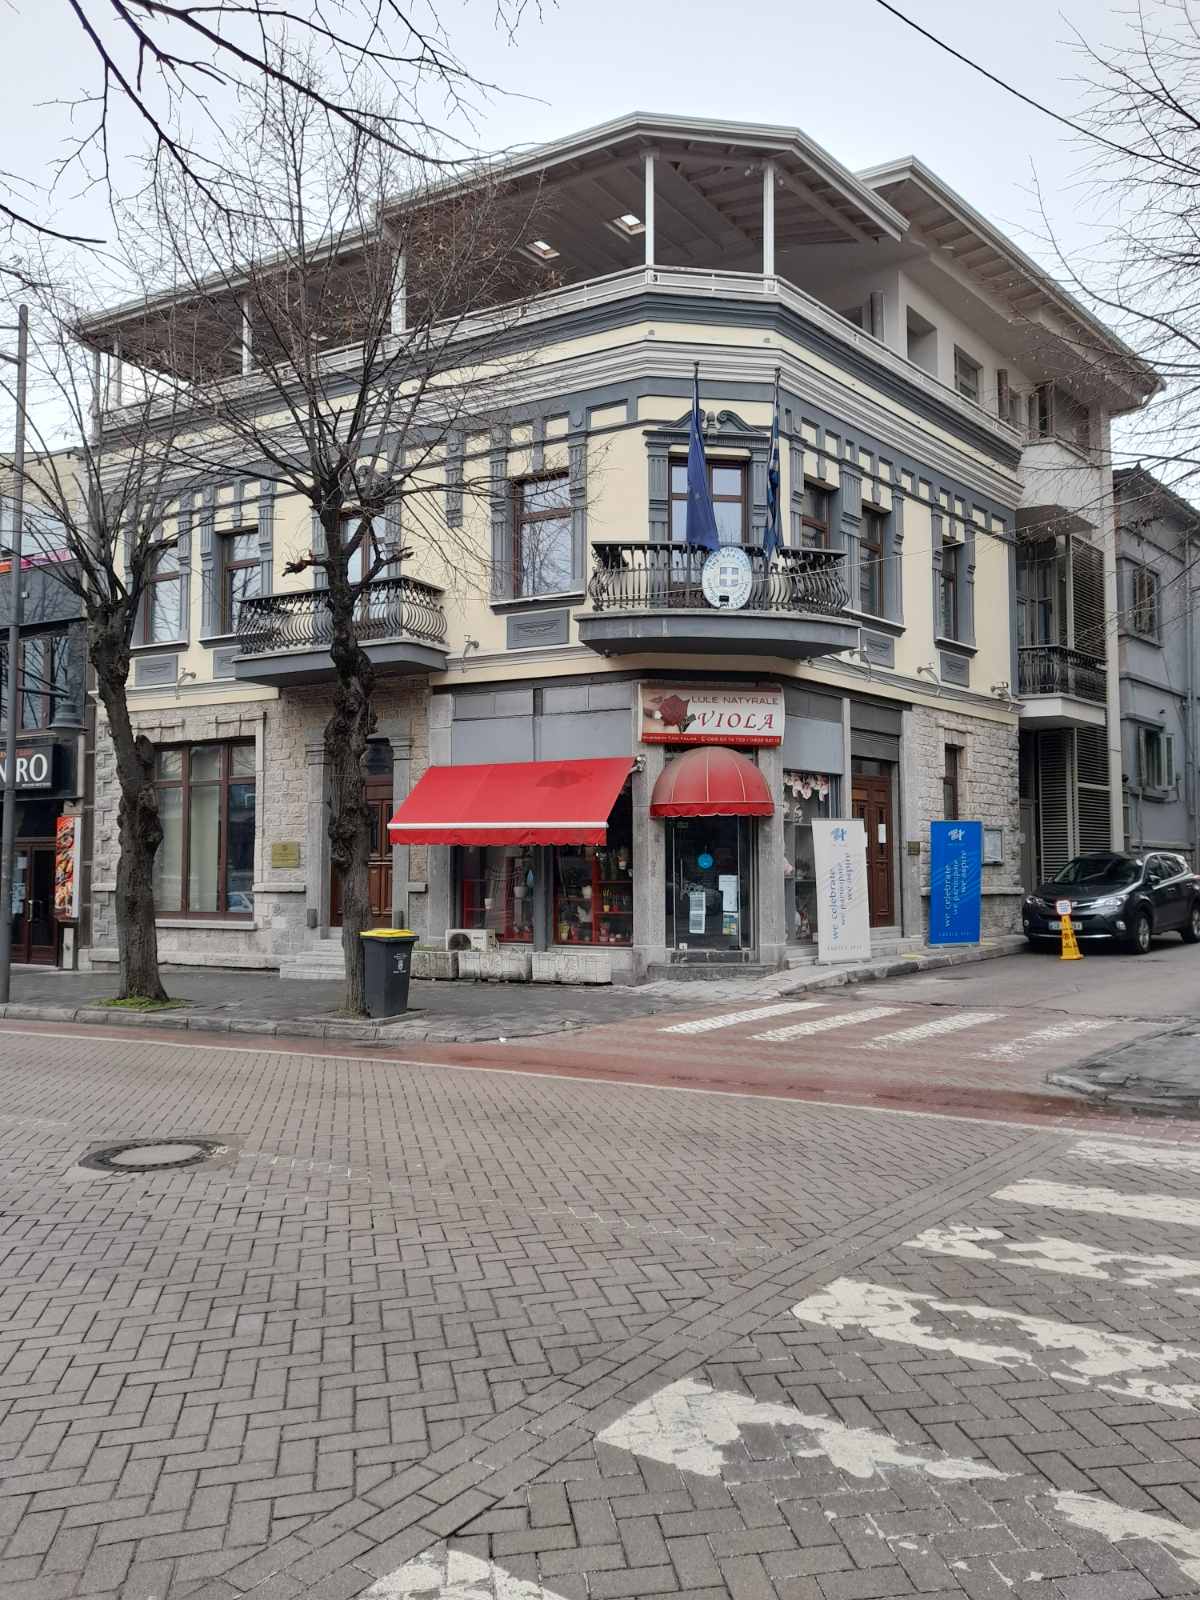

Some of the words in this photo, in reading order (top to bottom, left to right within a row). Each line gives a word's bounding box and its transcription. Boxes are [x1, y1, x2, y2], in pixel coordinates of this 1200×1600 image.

[691, 695, 718, 704] LULE
[723, 696, 779, 706] NATYRALE
[697, 710, 775, 730] VIOLA
[829, 868, 838, 920] celebrate
